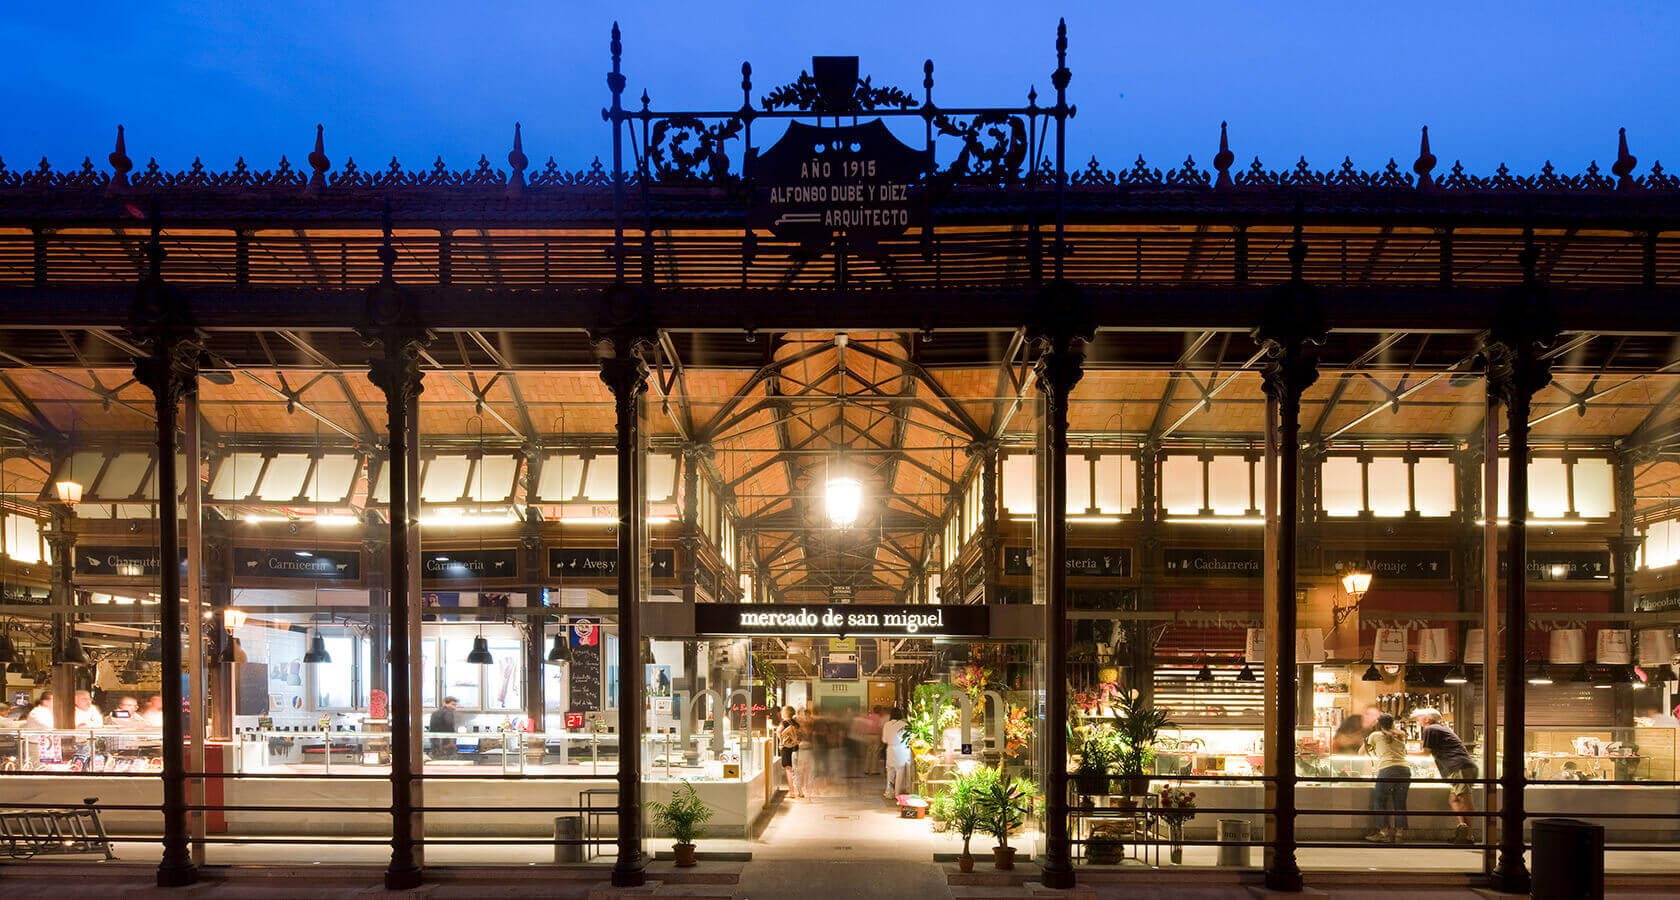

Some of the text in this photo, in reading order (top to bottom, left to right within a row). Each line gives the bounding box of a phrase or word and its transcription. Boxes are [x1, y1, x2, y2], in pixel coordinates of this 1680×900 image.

[801, 158, 876, 178] AÑO 1915
[770, 186, 827, 203] ALFONSO
[831, 180, 864, 201] DUBÉ
[868, 185, 876, 201] Y
[582, 557, 617, 571] Aves y
[1194, 557, 1259, 570] Cacharrería
[1366, 560, 1408, 575] Menaje
[740, 608, 944, 633] mercado de san miguel
[567, 715, 583, 727] 27
